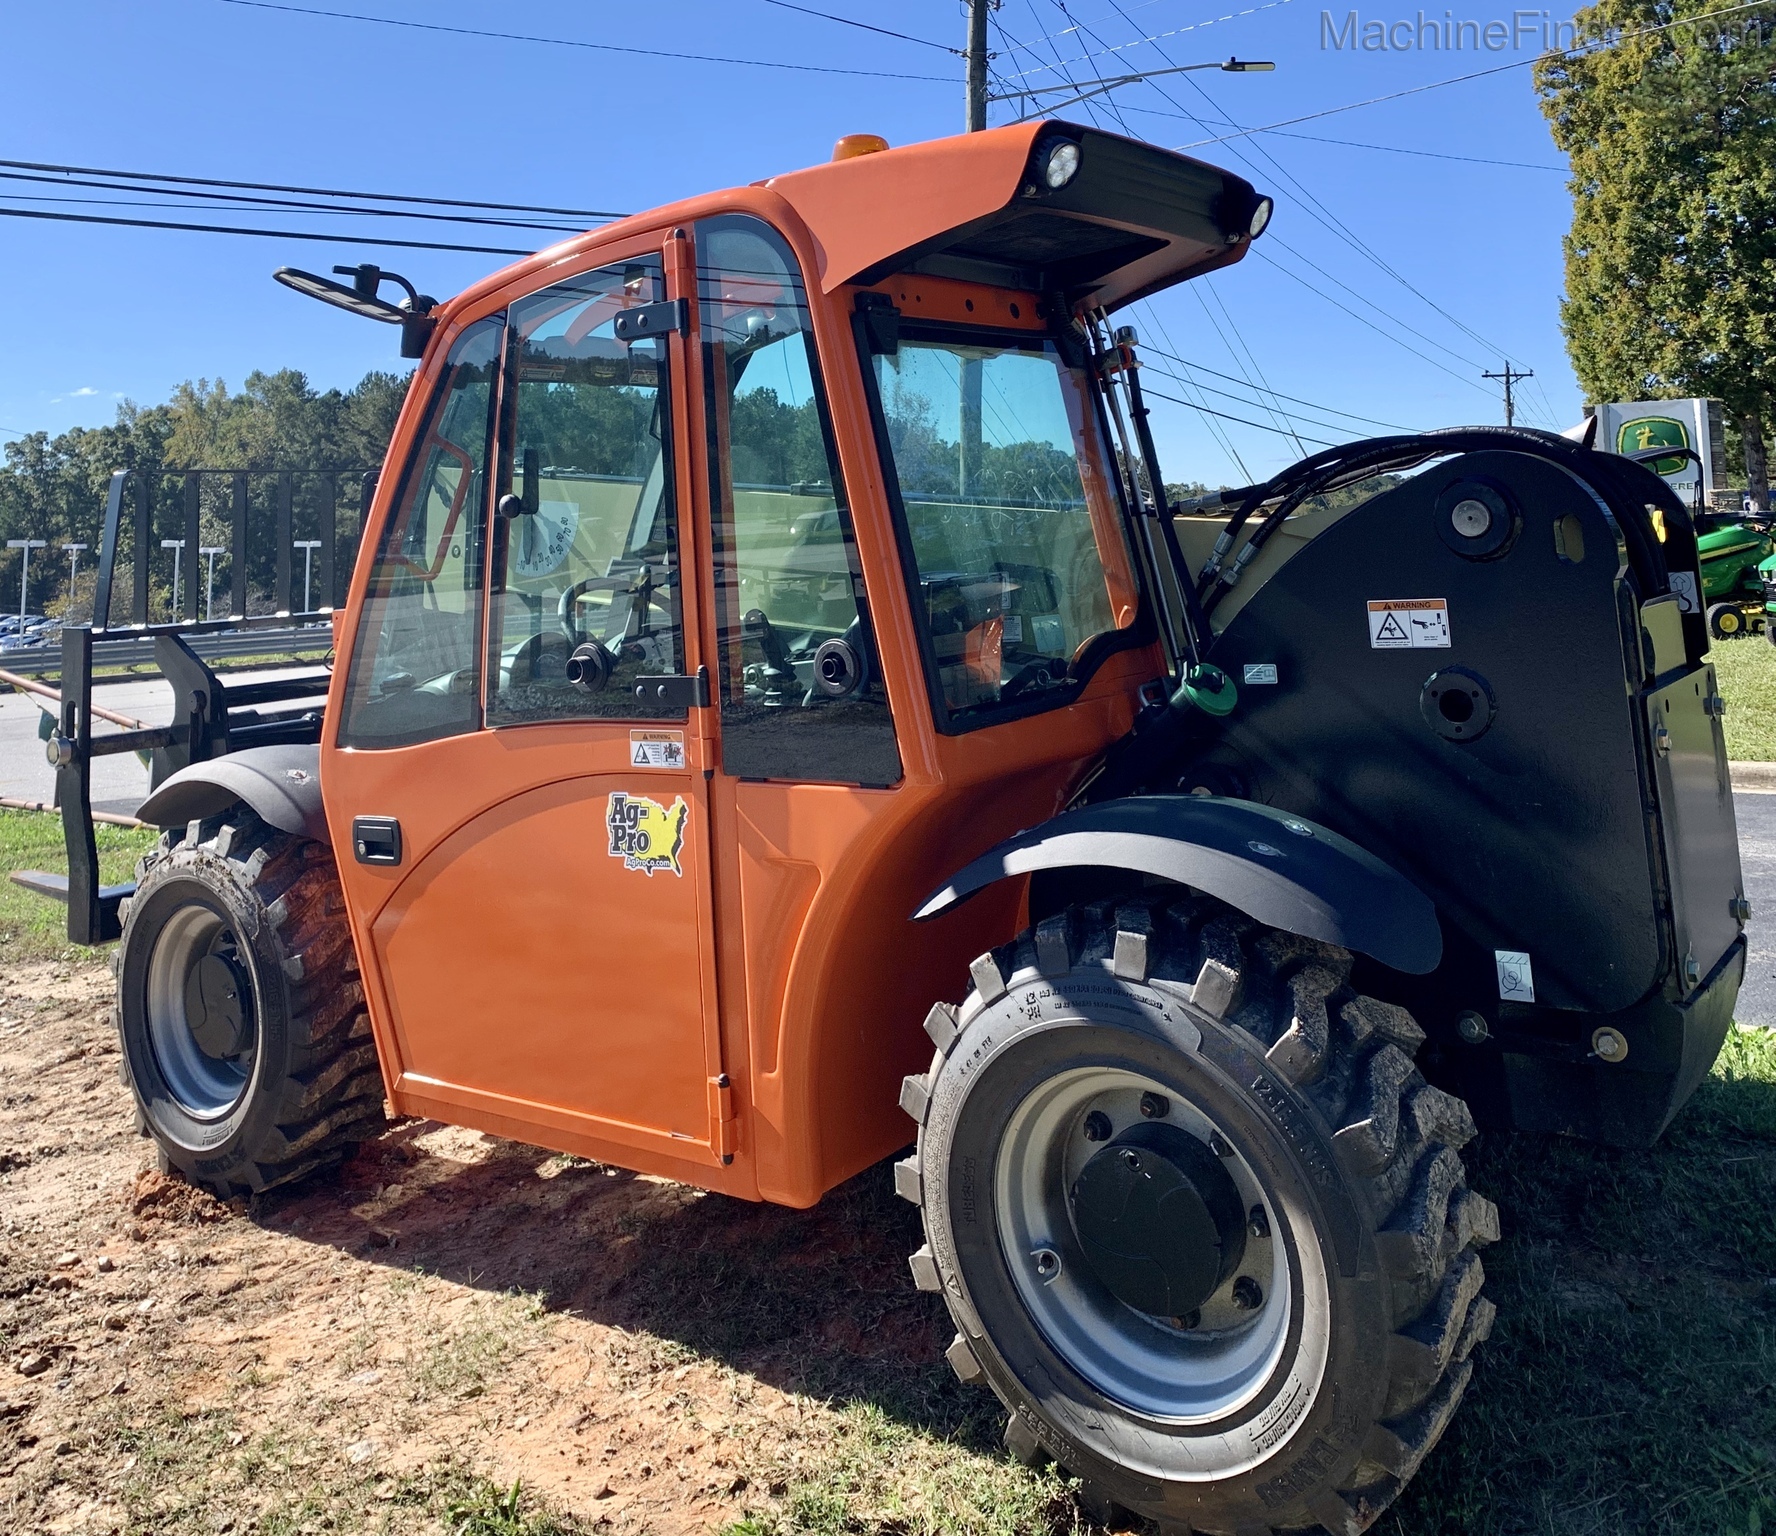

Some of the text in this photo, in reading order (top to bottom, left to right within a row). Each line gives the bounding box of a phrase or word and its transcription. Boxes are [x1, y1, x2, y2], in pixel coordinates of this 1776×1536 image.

[1670, 482, 1694, 490] ERE
[1392, 601, 1432, 609] WARNING
[610, 794, 649, 831] Ag-
[610, 825, 651, 855] Pro
[626, 857, 671, 868] AgProCo.com
